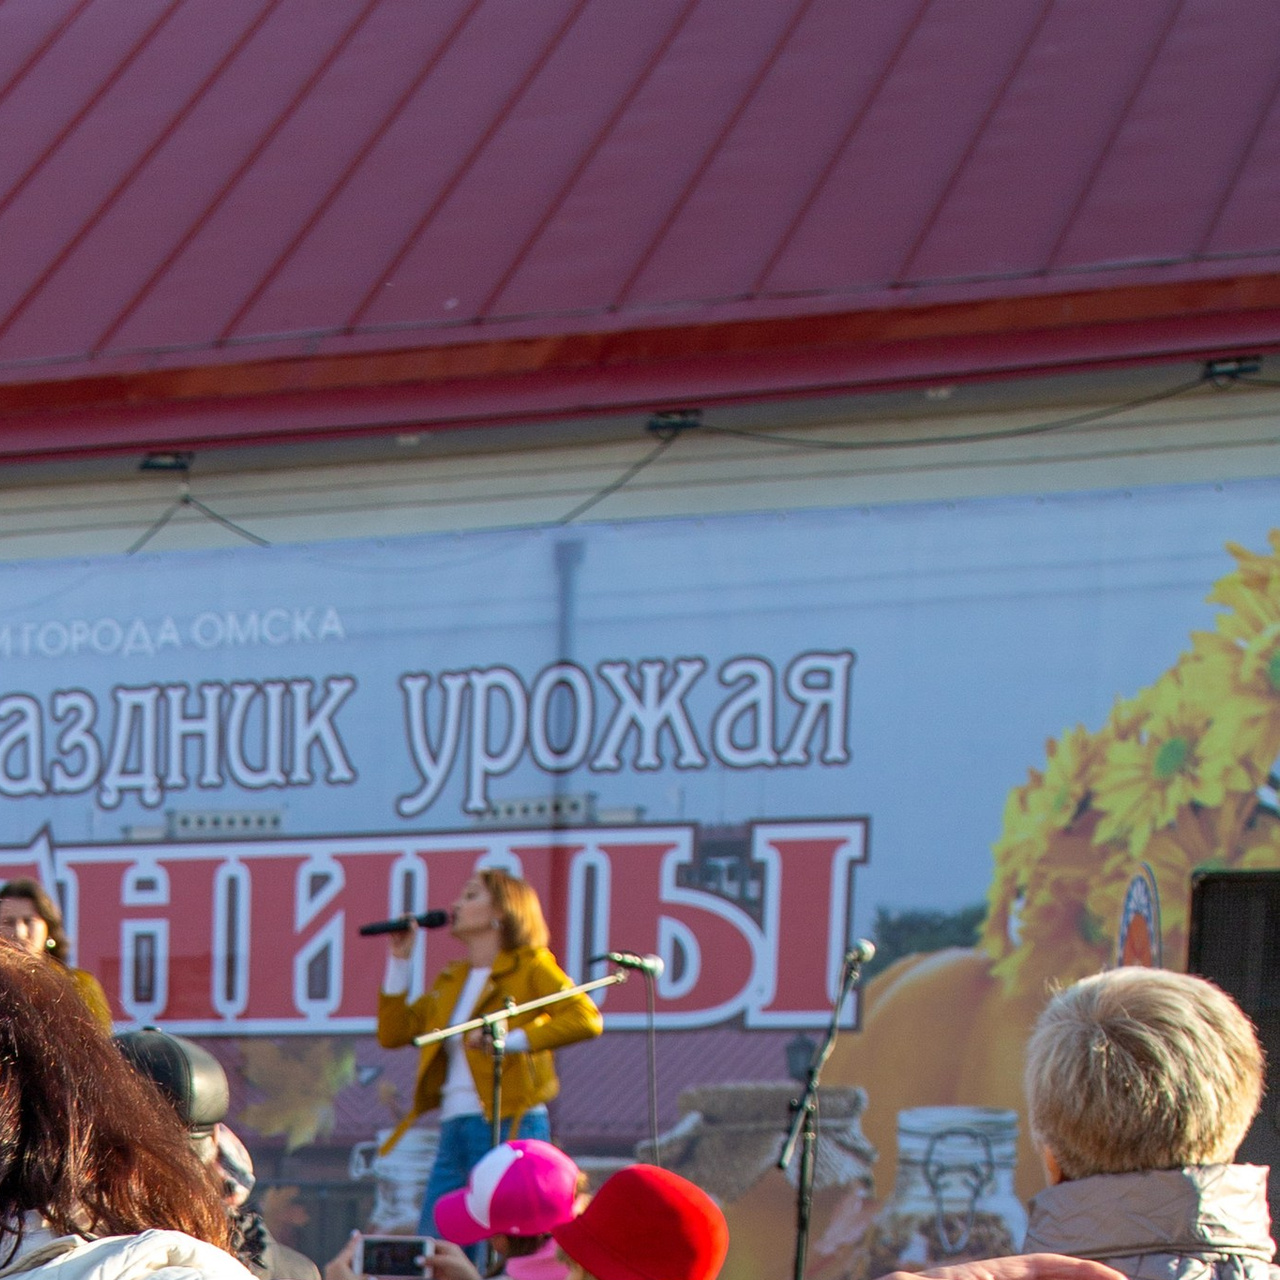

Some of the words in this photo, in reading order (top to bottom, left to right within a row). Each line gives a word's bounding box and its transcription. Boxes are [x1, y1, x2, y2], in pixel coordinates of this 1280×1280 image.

[24, 616, 181, 657] ГОРОДА
[191, 606, 346, 648] ОМСКА
[396, 647, 856, 818] урожая
